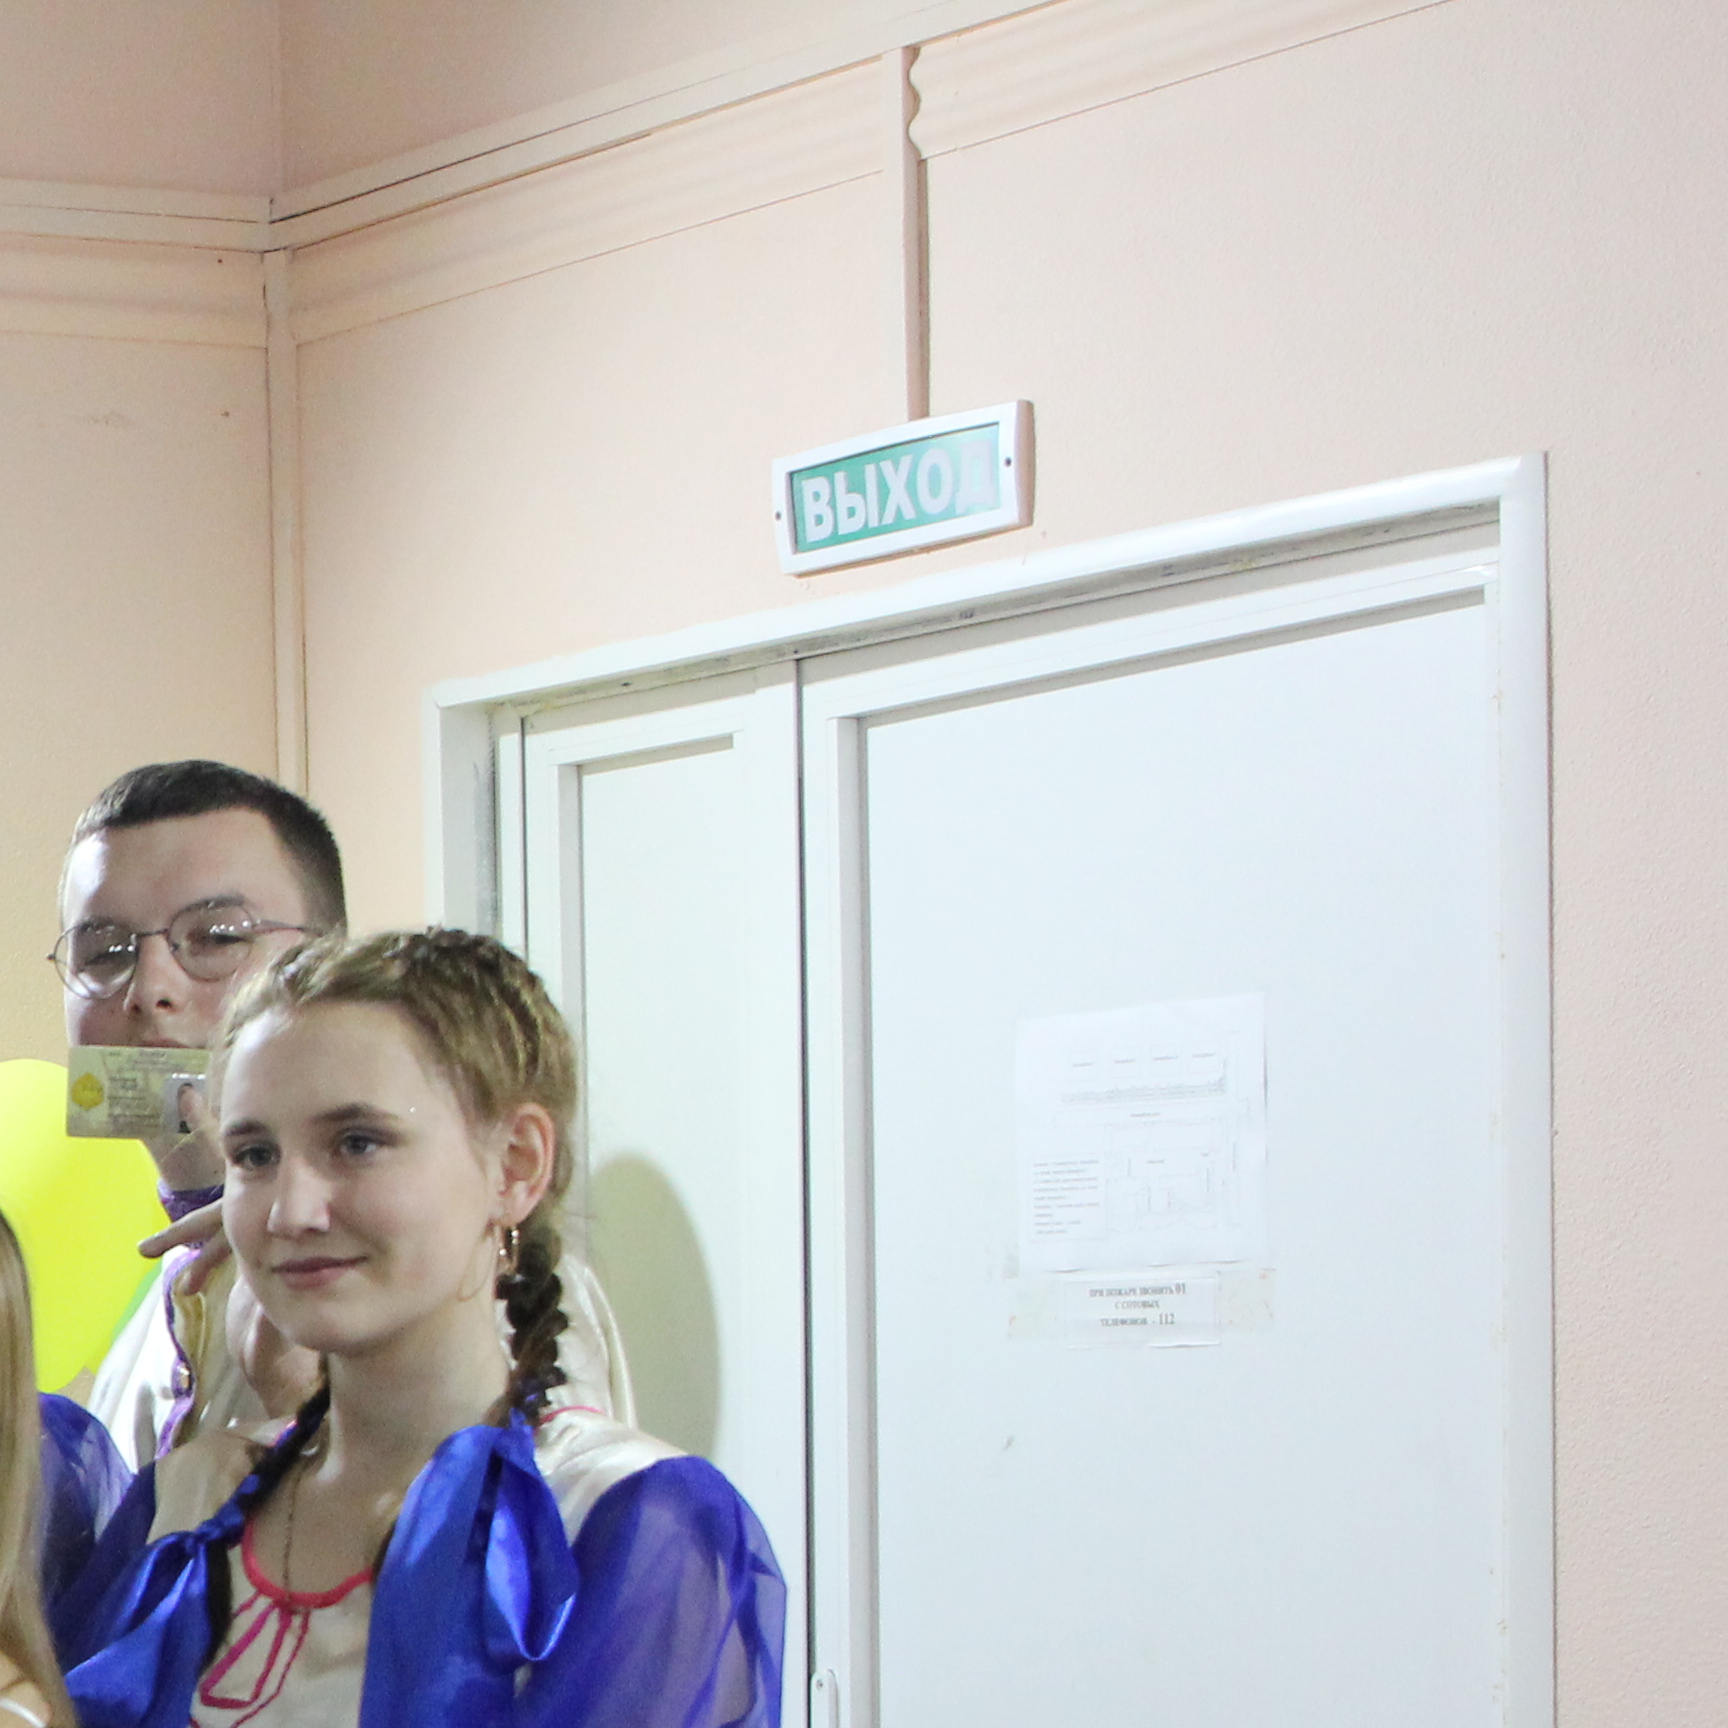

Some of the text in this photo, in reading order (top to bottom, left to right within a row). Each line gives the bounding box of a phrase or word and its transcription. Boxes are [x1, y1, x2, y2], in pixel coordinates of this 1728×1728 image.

[801, 438, 997, 544] ВЫХОД
[1089, 1288, 1104, 1298] ПРИ
[1105, 1287, 1137, 1297] ПОЖАРЕ
[1175, 1282, 1186, 1295] 01
[1159, 1312, 1176, 1326] 112
